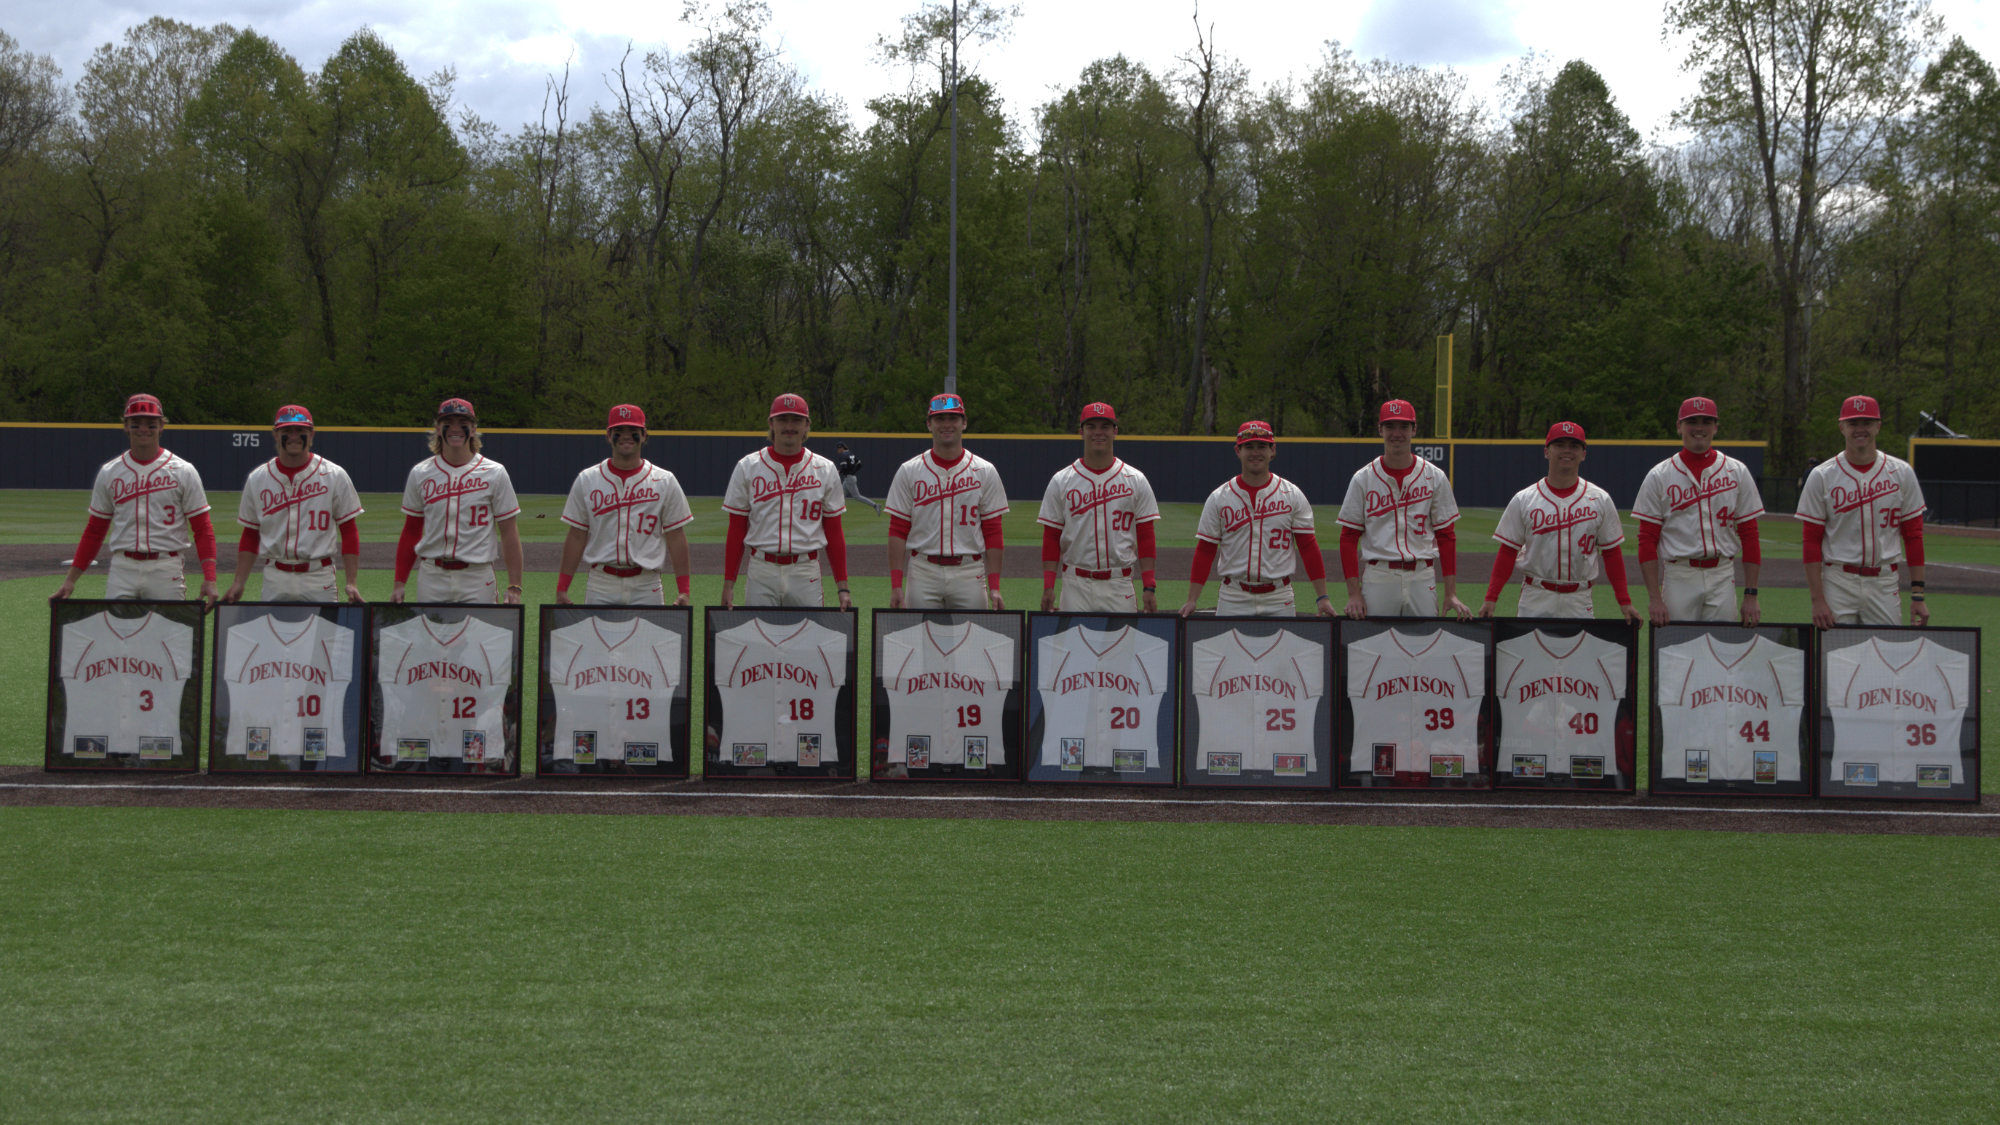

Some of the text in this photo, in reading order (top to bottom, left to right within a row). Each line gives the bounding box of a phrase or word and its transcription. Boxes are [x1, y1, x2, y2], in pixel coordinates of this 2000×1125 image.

[619, 407, 631, 419] DU
[784, 397, 796, 408] DU
[1093, 403, 1105, 415] DU
[1389, 403, 1401, 415] DU
[1692, 399, 1705, 411] DU
[1853, 398, 1866, 412] DU
[1562, 423, 1574, 434] DU
[232, 433, 260, 447] 375
[1415, 446, 1444, 462] 330
[111, 473, 178, 504] Denison
[260, 481, 328, 516] Denison
[423, 475, 489, 504] Denison
[752, 473, 821, 503] Denison
[914, 478, 981, 507] Denison
[1667, 476, 1738, 513] Denison
[1831, 480, 1899, 514] Denison
[589, 486, 660, 516] Denison
[800, 499, 822, 521] 18
[1067, 484, 1132, 516] Denison
[1366, 486, 1433, 518] Denison
[163, 505, 176, 525] 3
[308, 510, 330, 531] 10
[469, 506, 488, 526] 12
[637, 513, 658, 535] 13
[1112, 510, 1133, 531] 20
[1220, 499, 1292, 532] Denison
[1530, 506, 1597, 535] Denison
[1879, 508, 1901, 529] 36
[1269, 527, 1292, 550] 25
[1578, 533, 1595, 555] 40
[85, 657, 162, 683] DENISON
[250, 661, 327, 686] DENISON
[407, 661, 482, 688] DENISON
[575, 665, 652, 690] DENISON
[740, 662, 819, 691] DENISON
[906, 672, 986, 697] DENISON
[1060, 671, 1139, 697] DENISON
[1218, 674, 1297, 700] DENISON
[1376, 675, 1455, 701] DENISON
[1519, 676, 1599, 704] DENISON
[140, 690, 153, 711] 3
[298, 695, 320, 717] 10
[453, 697, 476, 718] 12
[1691, 685, 1767, 710] DENISON
[1858, 688, 1936, 713] DENISON
[626, 698, 649, 720] 13
[790, 699, 814, 720] 18
[957, 705, 981, 728] 19
[1111, 707, 1140, 729] 20
[1266, 709, 1295, 731] 25
[1425, 708, 1454, 731] 39
[1568, 713, 1598, 734] 40
[1740, 720, 1769, 742] 44
[1907, 724, 1935, 746] 36
